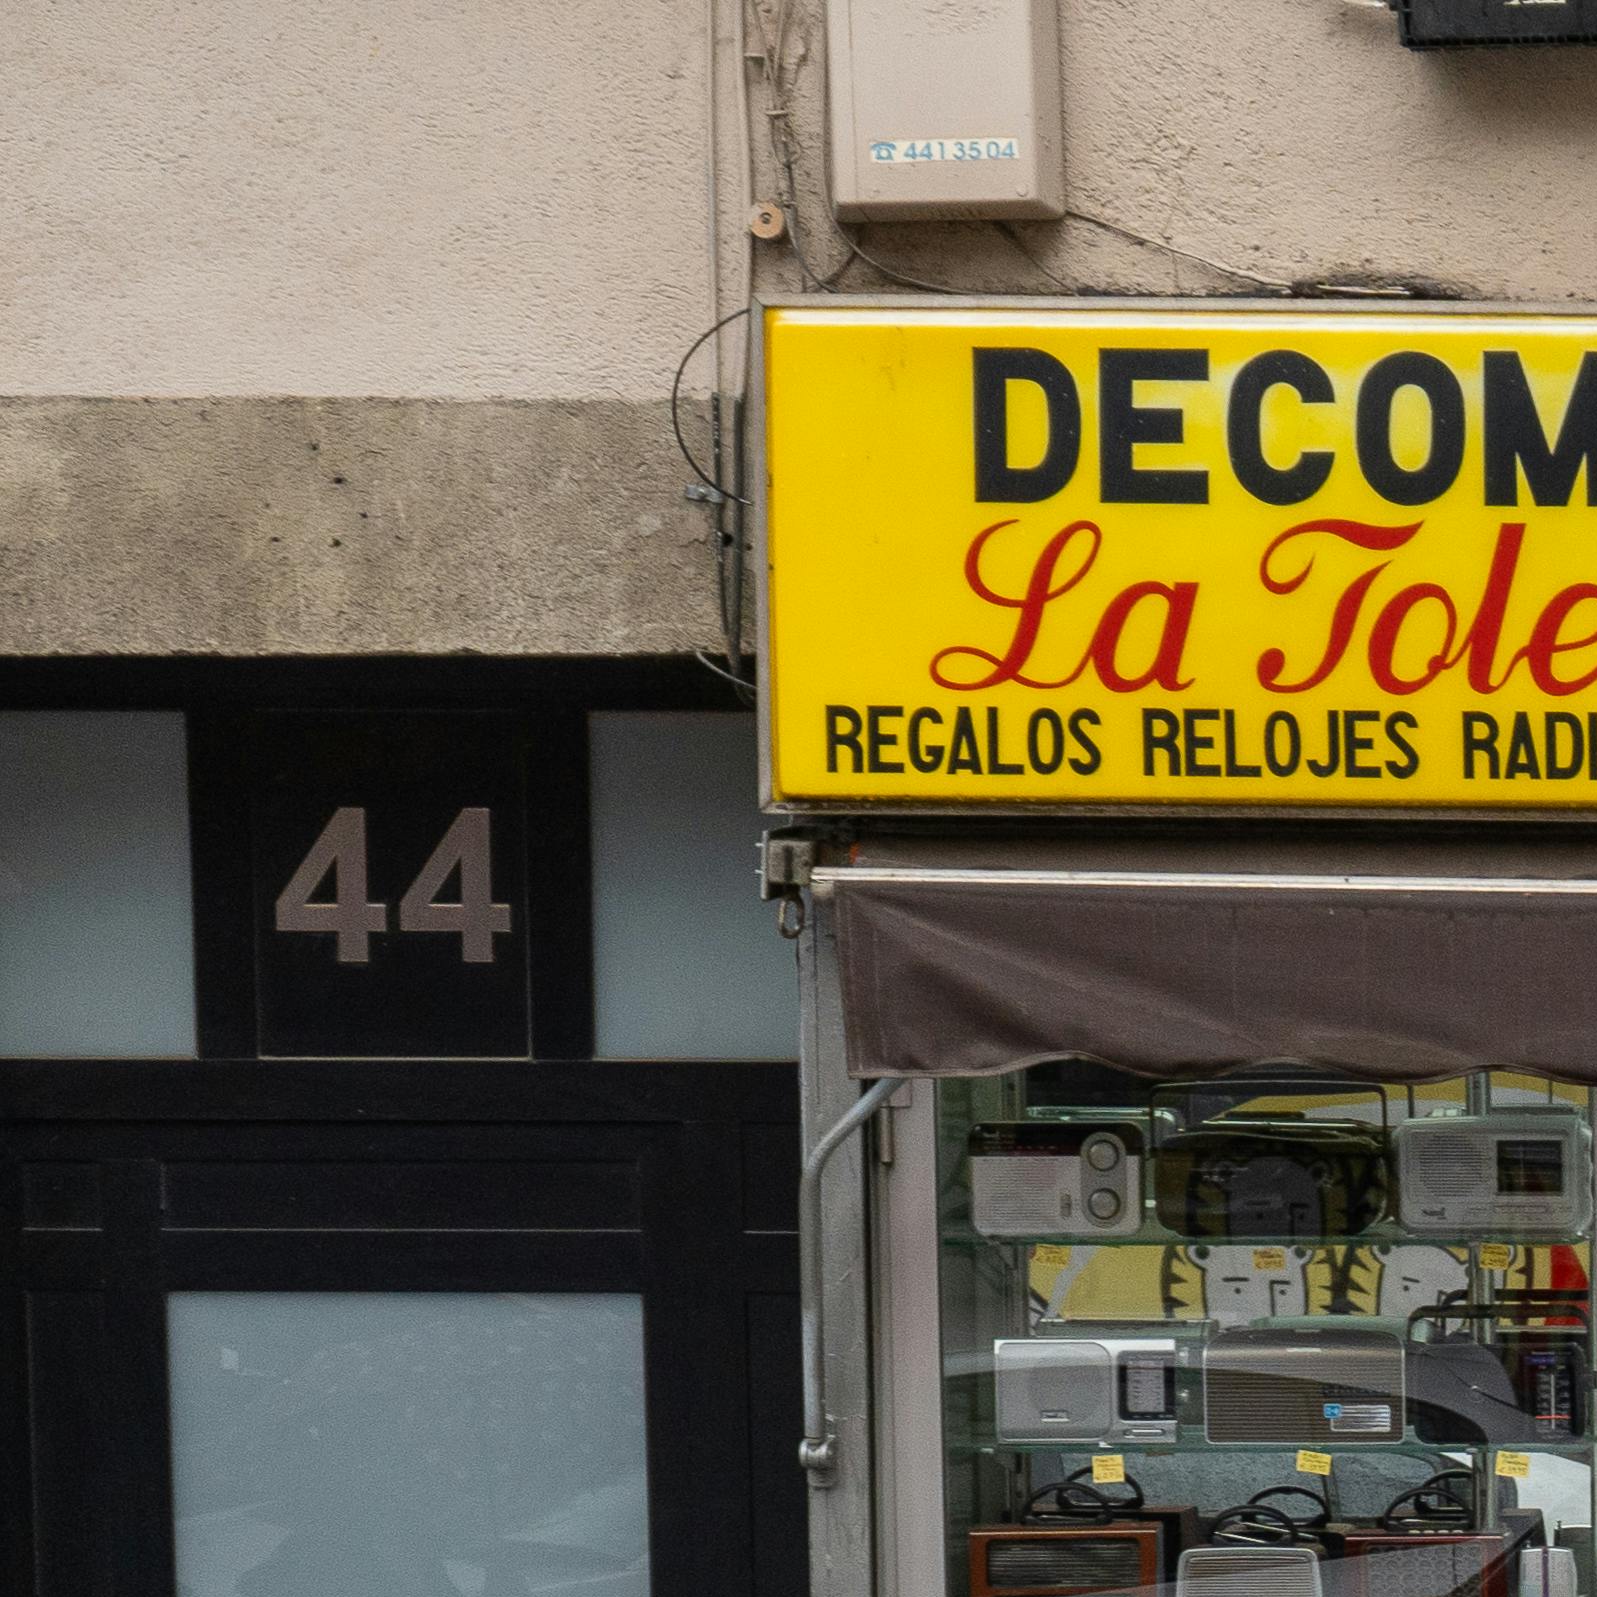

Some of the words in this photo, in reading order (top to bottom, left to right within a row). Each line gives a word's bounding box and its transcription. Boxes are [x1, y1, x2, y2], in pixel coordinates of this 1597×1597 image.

[931, 520, 1198, 692] La
[827, 706, 1101, 775] REGALOS
[1143, 709, 1419, 779] RELOJES
[276, 807, 512, 963] 44
